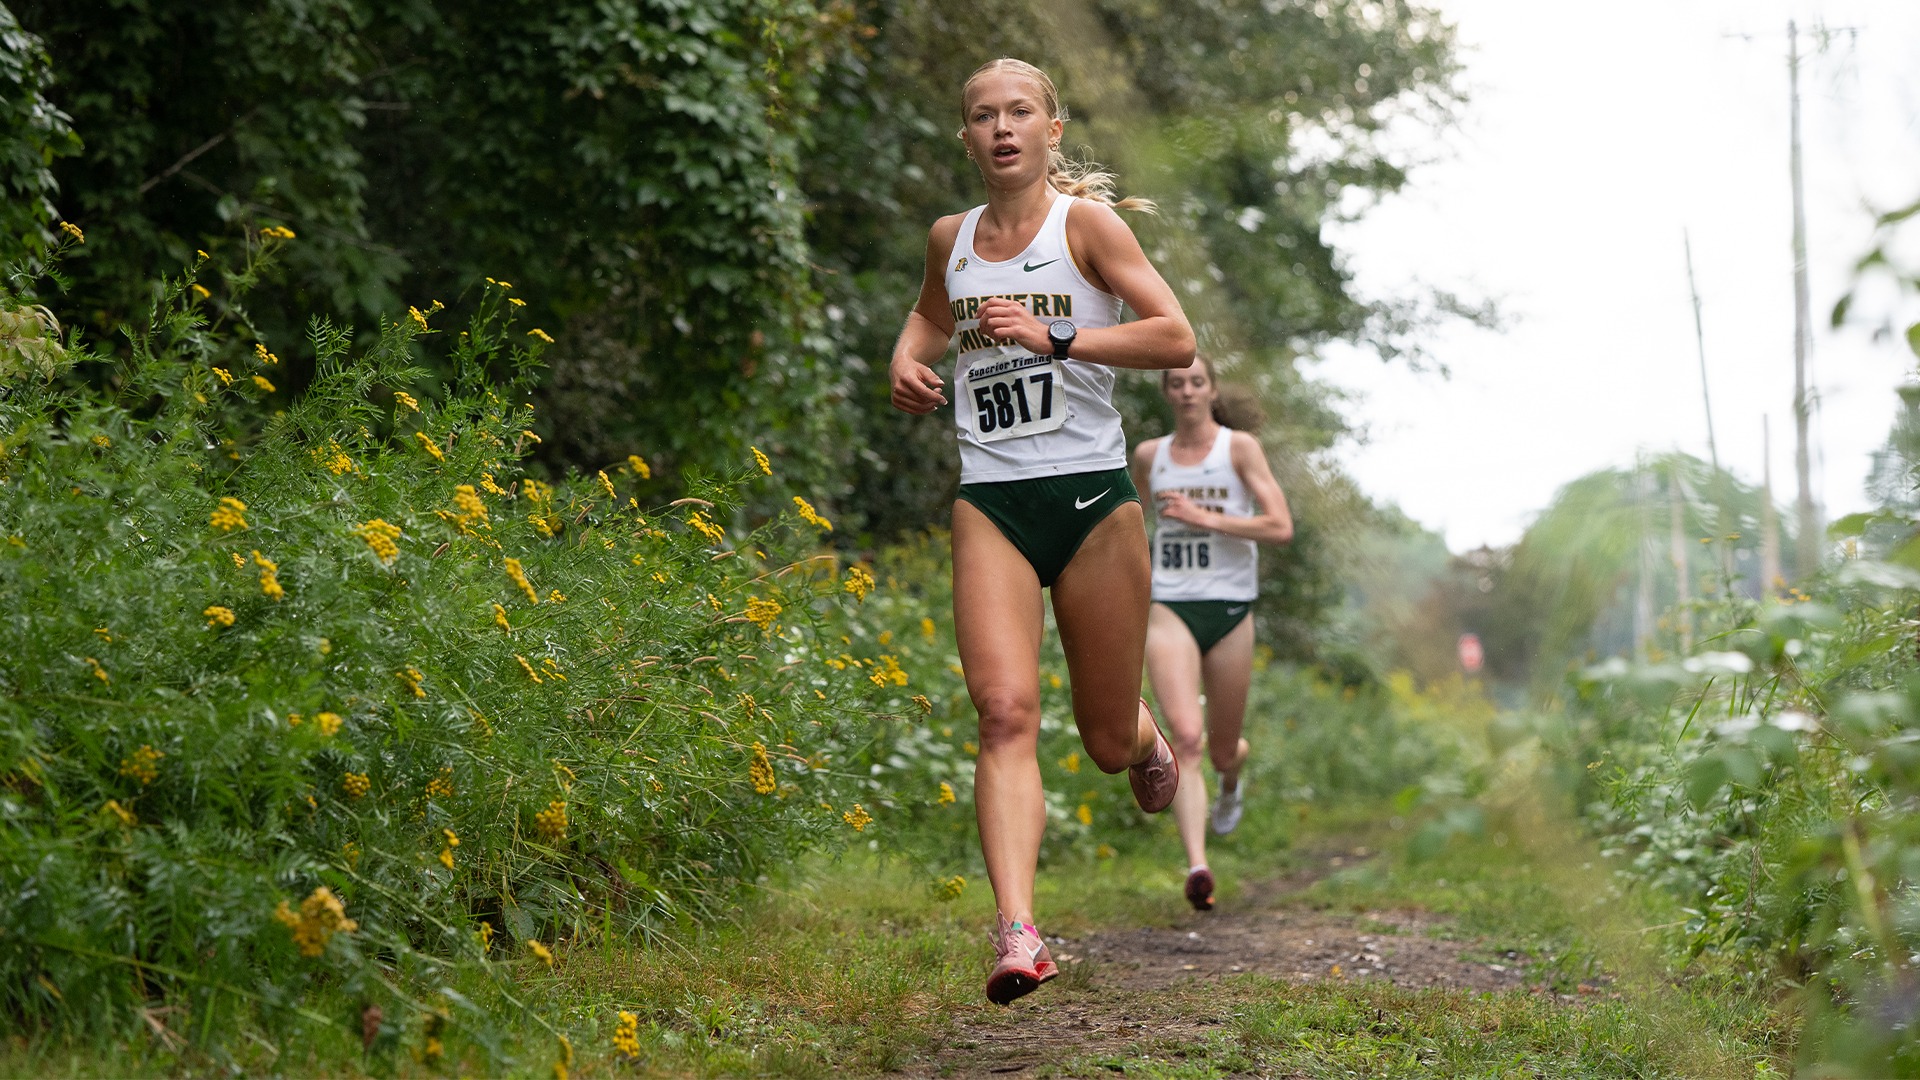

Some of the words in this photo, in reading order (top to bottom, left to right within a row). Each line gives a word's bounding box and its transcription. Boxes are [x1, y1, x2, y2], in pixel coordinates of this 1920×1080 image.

[950, 293, 1072, 322] NORERN
[968, 361, 1010, 378] Superior
[1011, 355, 1052, 368] Timing
[973, 372, 1053, 433] 5817
[1162, 543, 1209, 569] 5816
